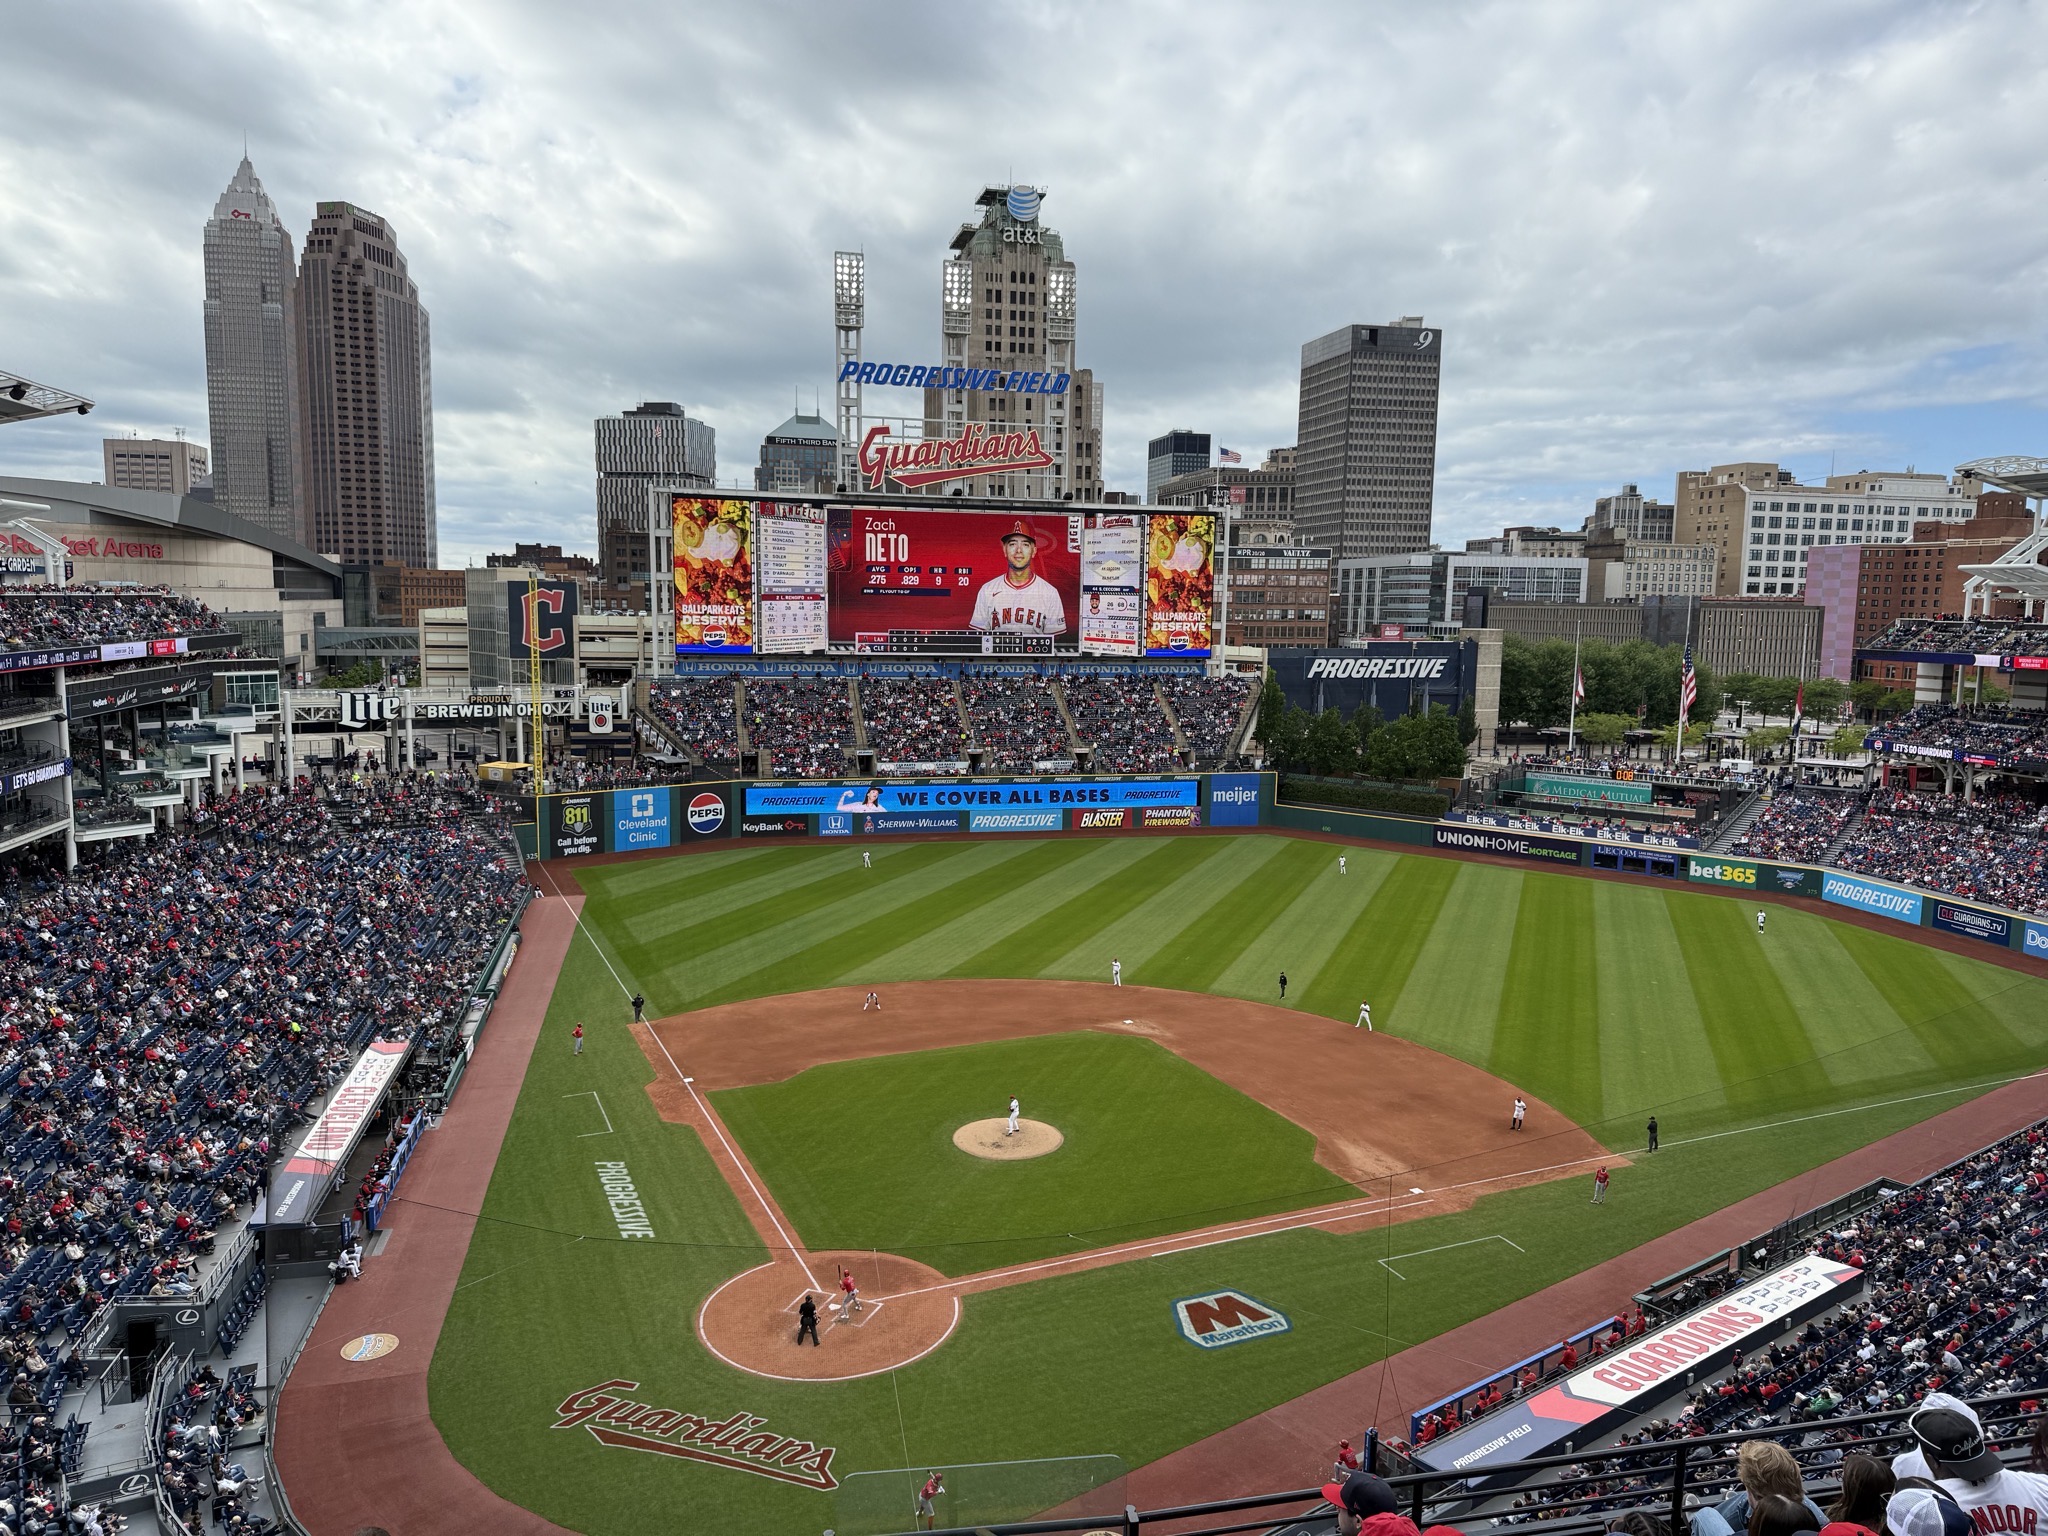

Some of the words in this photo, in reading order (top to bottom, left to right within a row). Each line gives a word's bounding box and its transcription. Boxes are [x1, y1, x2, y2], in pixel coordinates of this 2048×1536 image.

[1003, 222, 1044, 245] at&t
[1417, 331, 1433, 350] 9
[838, 361, 1001, 391] PROGRESSIVE
[1004, 371, 1071, 394] FIELD
[858, 423, 1055, 490] Guardians
[782, 505, 817, 519] ANGELS
[865, 517, 895, 531] Zach
[1069, 515, 1081, 551] ANGEL
[12, 534, 100, 557] Roket
[103, 537, 164, 559] Arena
[865, 532, 909, 562] NETO
[8, 557, 36, 572] GARDEN
[868, 575, 886, 584] .275
[901, 575, 919, 585] .829
[935, 576, 941, 586] 9
[958, 576, 969, 586] 20
[682, 604, 723, 615] BALLPARK
[724, 605, 745, 615] EATS
[1152, 611, 1187, 621] BALLPARK
[1188, 612, 1207, 621] EATS
[521, 588, 566, 652] C
[682, 615, 746, 626] DESERVE
[991, 606, 1046, 630] ANGEL
[1152, 622, 1206, 631] DESERVE
[38, 654, 48, 664] 5.02
[698, 663, 760, 672] HONDA
[778, 664, 837, 672] HONDA
[880, 665, 937, 673] HONDA
[983, 665, 1037, 673] HONDA
[1080, 665, 1132, 673] HONDA
[1148, 665, 1200, 673] HONDA
[1307, 658, 1448, 679] PROGRESSIVE
[470, 695, 512, 703] PROUDLY
[337, 691, 400, 729] Lite
[427, 704, 495, 718] BREWED
[497, 704, 513, 717] IN
[516, 703, 551, 716] OHIO
[591, 702, 610, 713] Lite
[1892, 743, 1909, 753] LET'S
[1909, 744, 1918, 754] GO
[1918, 746, 1953, 759] GUARDIANS!
[13, 772, 28, 790] LET'S
[28, 770, 36, 785] GO
[36, 762, 65, 783] GUARDIANS!
[1616, 770, 1634, 781] 0:08
[761, 796, 827, 807] PROGRESSIVE
[897, 791, 929, 806] WE
[935, 790, 1001, 806] COVER
[1008, 790, 1043, 804] ALL
[1049, 789, 1110, 804] BASES
[1124, 790, 1182, 799] PROGRESSIVE
[1213, 787, 1257, 805] meijer
[1552, 785, 1597, 798] MEDICAL
[1601, 789, 1645, 803] MUTUAL
[564, 808, 589, 825] 811
[690, 808, 723, 819] PEPSI
[972, 814, 1057, 828] PROGRESSIVE
[1080, 811, 1124, 828] BLASTER
[1145, 809, 1191, 818] PHANTOM
[618, 817, 667, 831] Cleveland
[743, 823, 783, 833] KeyBank
[878, 819, 959, 829] SHERWIN-WILLIAMS.
[1144, 818, 1191, 827] FIREWORKS
[557, 838, 572, 847] Call
[573, 836, 597, 845] before
[628, 831, 657, 843] Clinic
[563, 847, 577, 856] you
[578, 845, 592, 855] dig.
[1529, 847, 1577, 860] MORTGAGE
[1690, 861, 1756, 884] bet365
[1824, 879, 1916, 915] PROGRESSIVE
[303, 1086, 378, 1151] CLEVELAND
[594, 1161, 656, 1239] PROGRESSIVE
[1201, 1319, 1284, 1345] Marathon
[1593, 1304, 1764, 1392] GUARDIANS
[550, 1378, 839, 1491] Guardians
[1453, 1435, 1509, 1470] PROGRESSIVE
[1508, 1423, 1532, 1446] FIELD
[1968, 1504, 2038, 1536] NDOR
